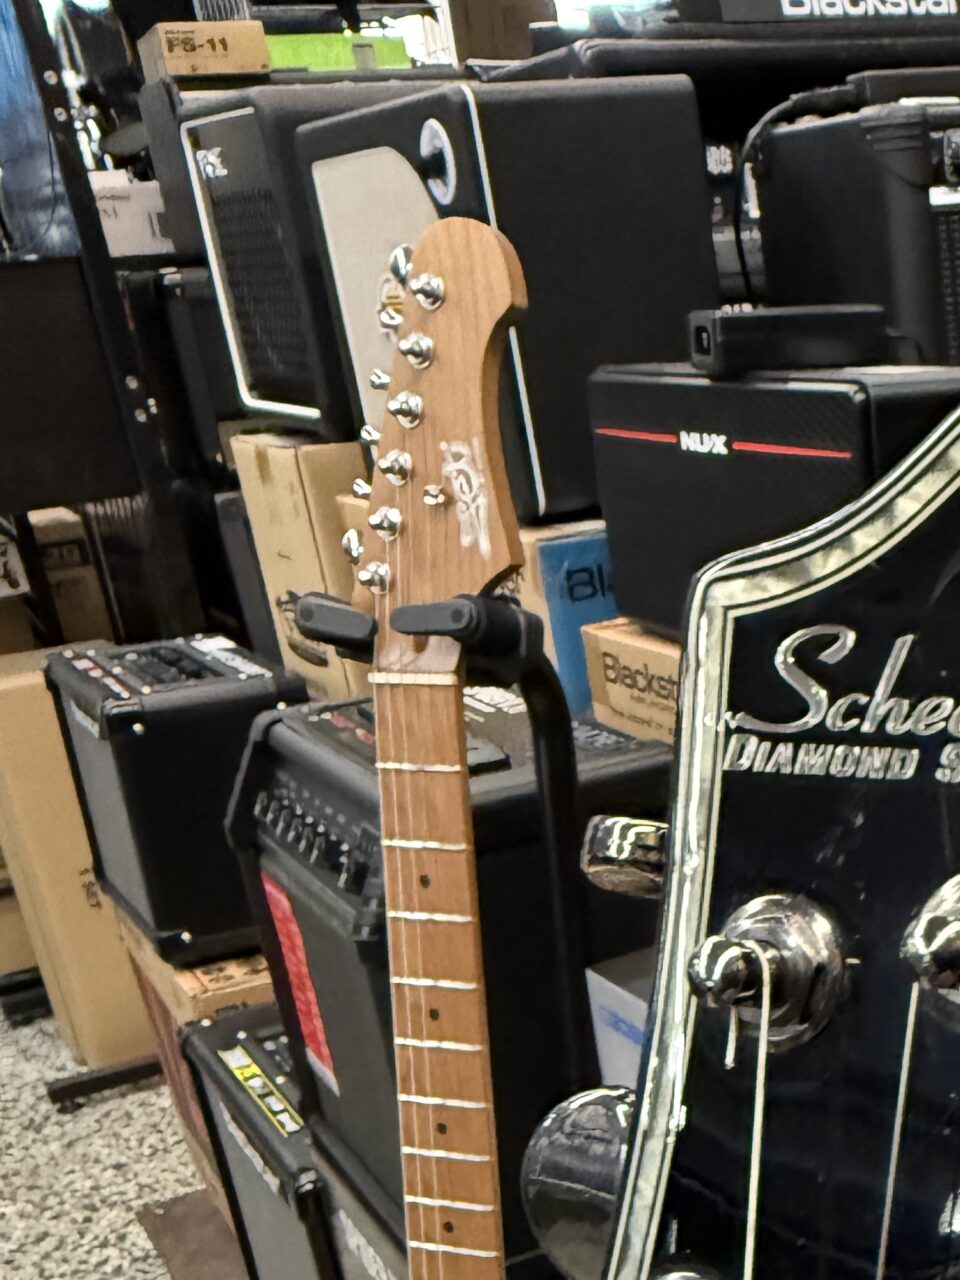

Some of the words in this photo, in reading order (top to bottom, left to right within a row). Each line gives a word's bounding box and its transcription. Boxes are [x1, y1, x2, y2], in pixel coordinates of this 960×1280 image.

[679, 430, 729, 455] NUX
[566, 563, 612, 603] Bl
[722, 733, 920, 780] DIAMOND
